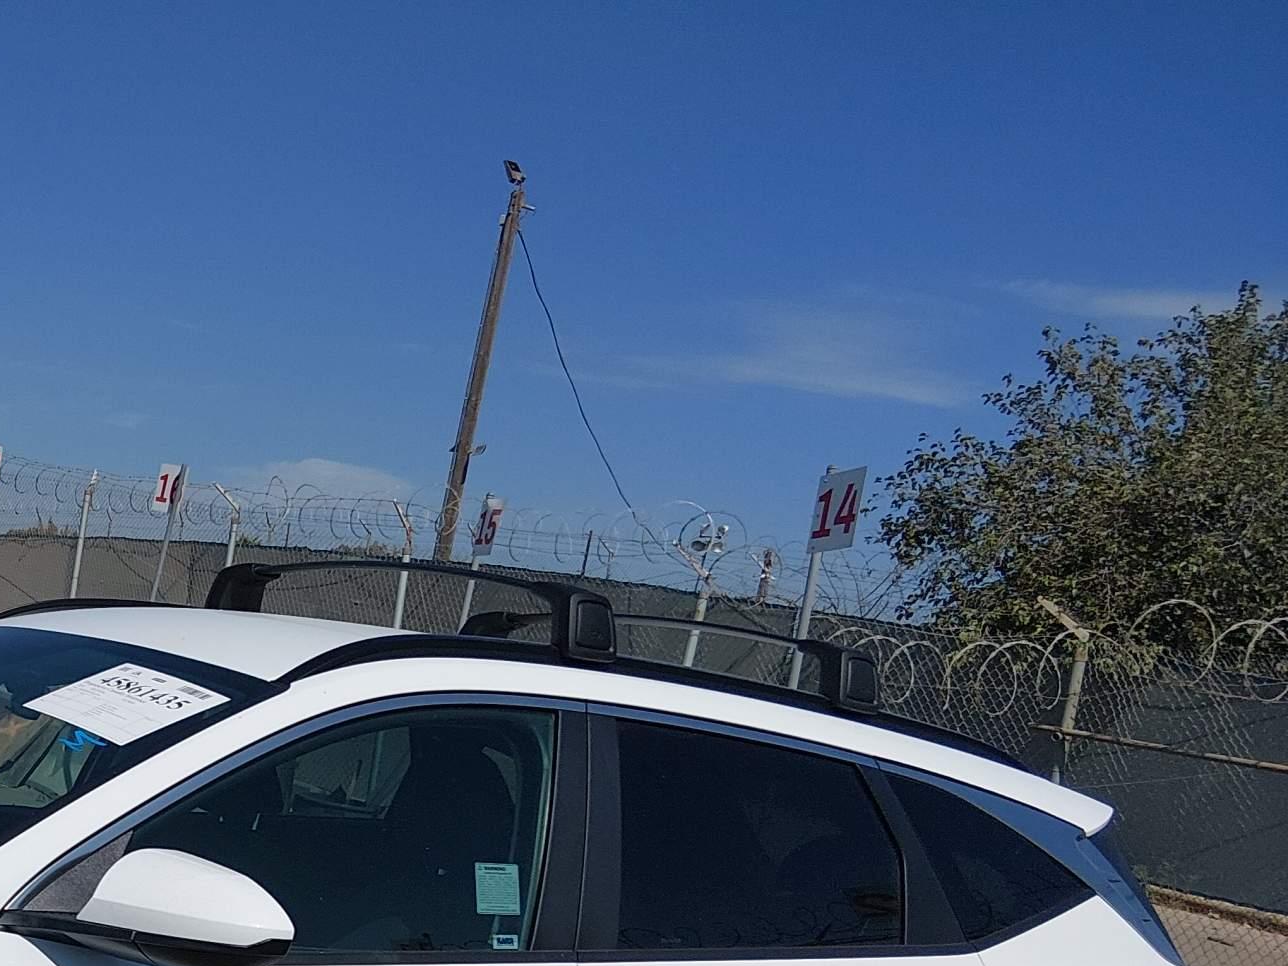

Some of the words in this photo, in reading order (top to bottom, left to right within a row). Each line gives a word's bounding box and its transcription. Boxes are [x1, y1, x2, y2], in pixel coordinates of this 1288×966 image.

[474, 509, 503, 545] 15
[812, 483, 858, 539] 14
[100, 676, 193, 710] 45861435
